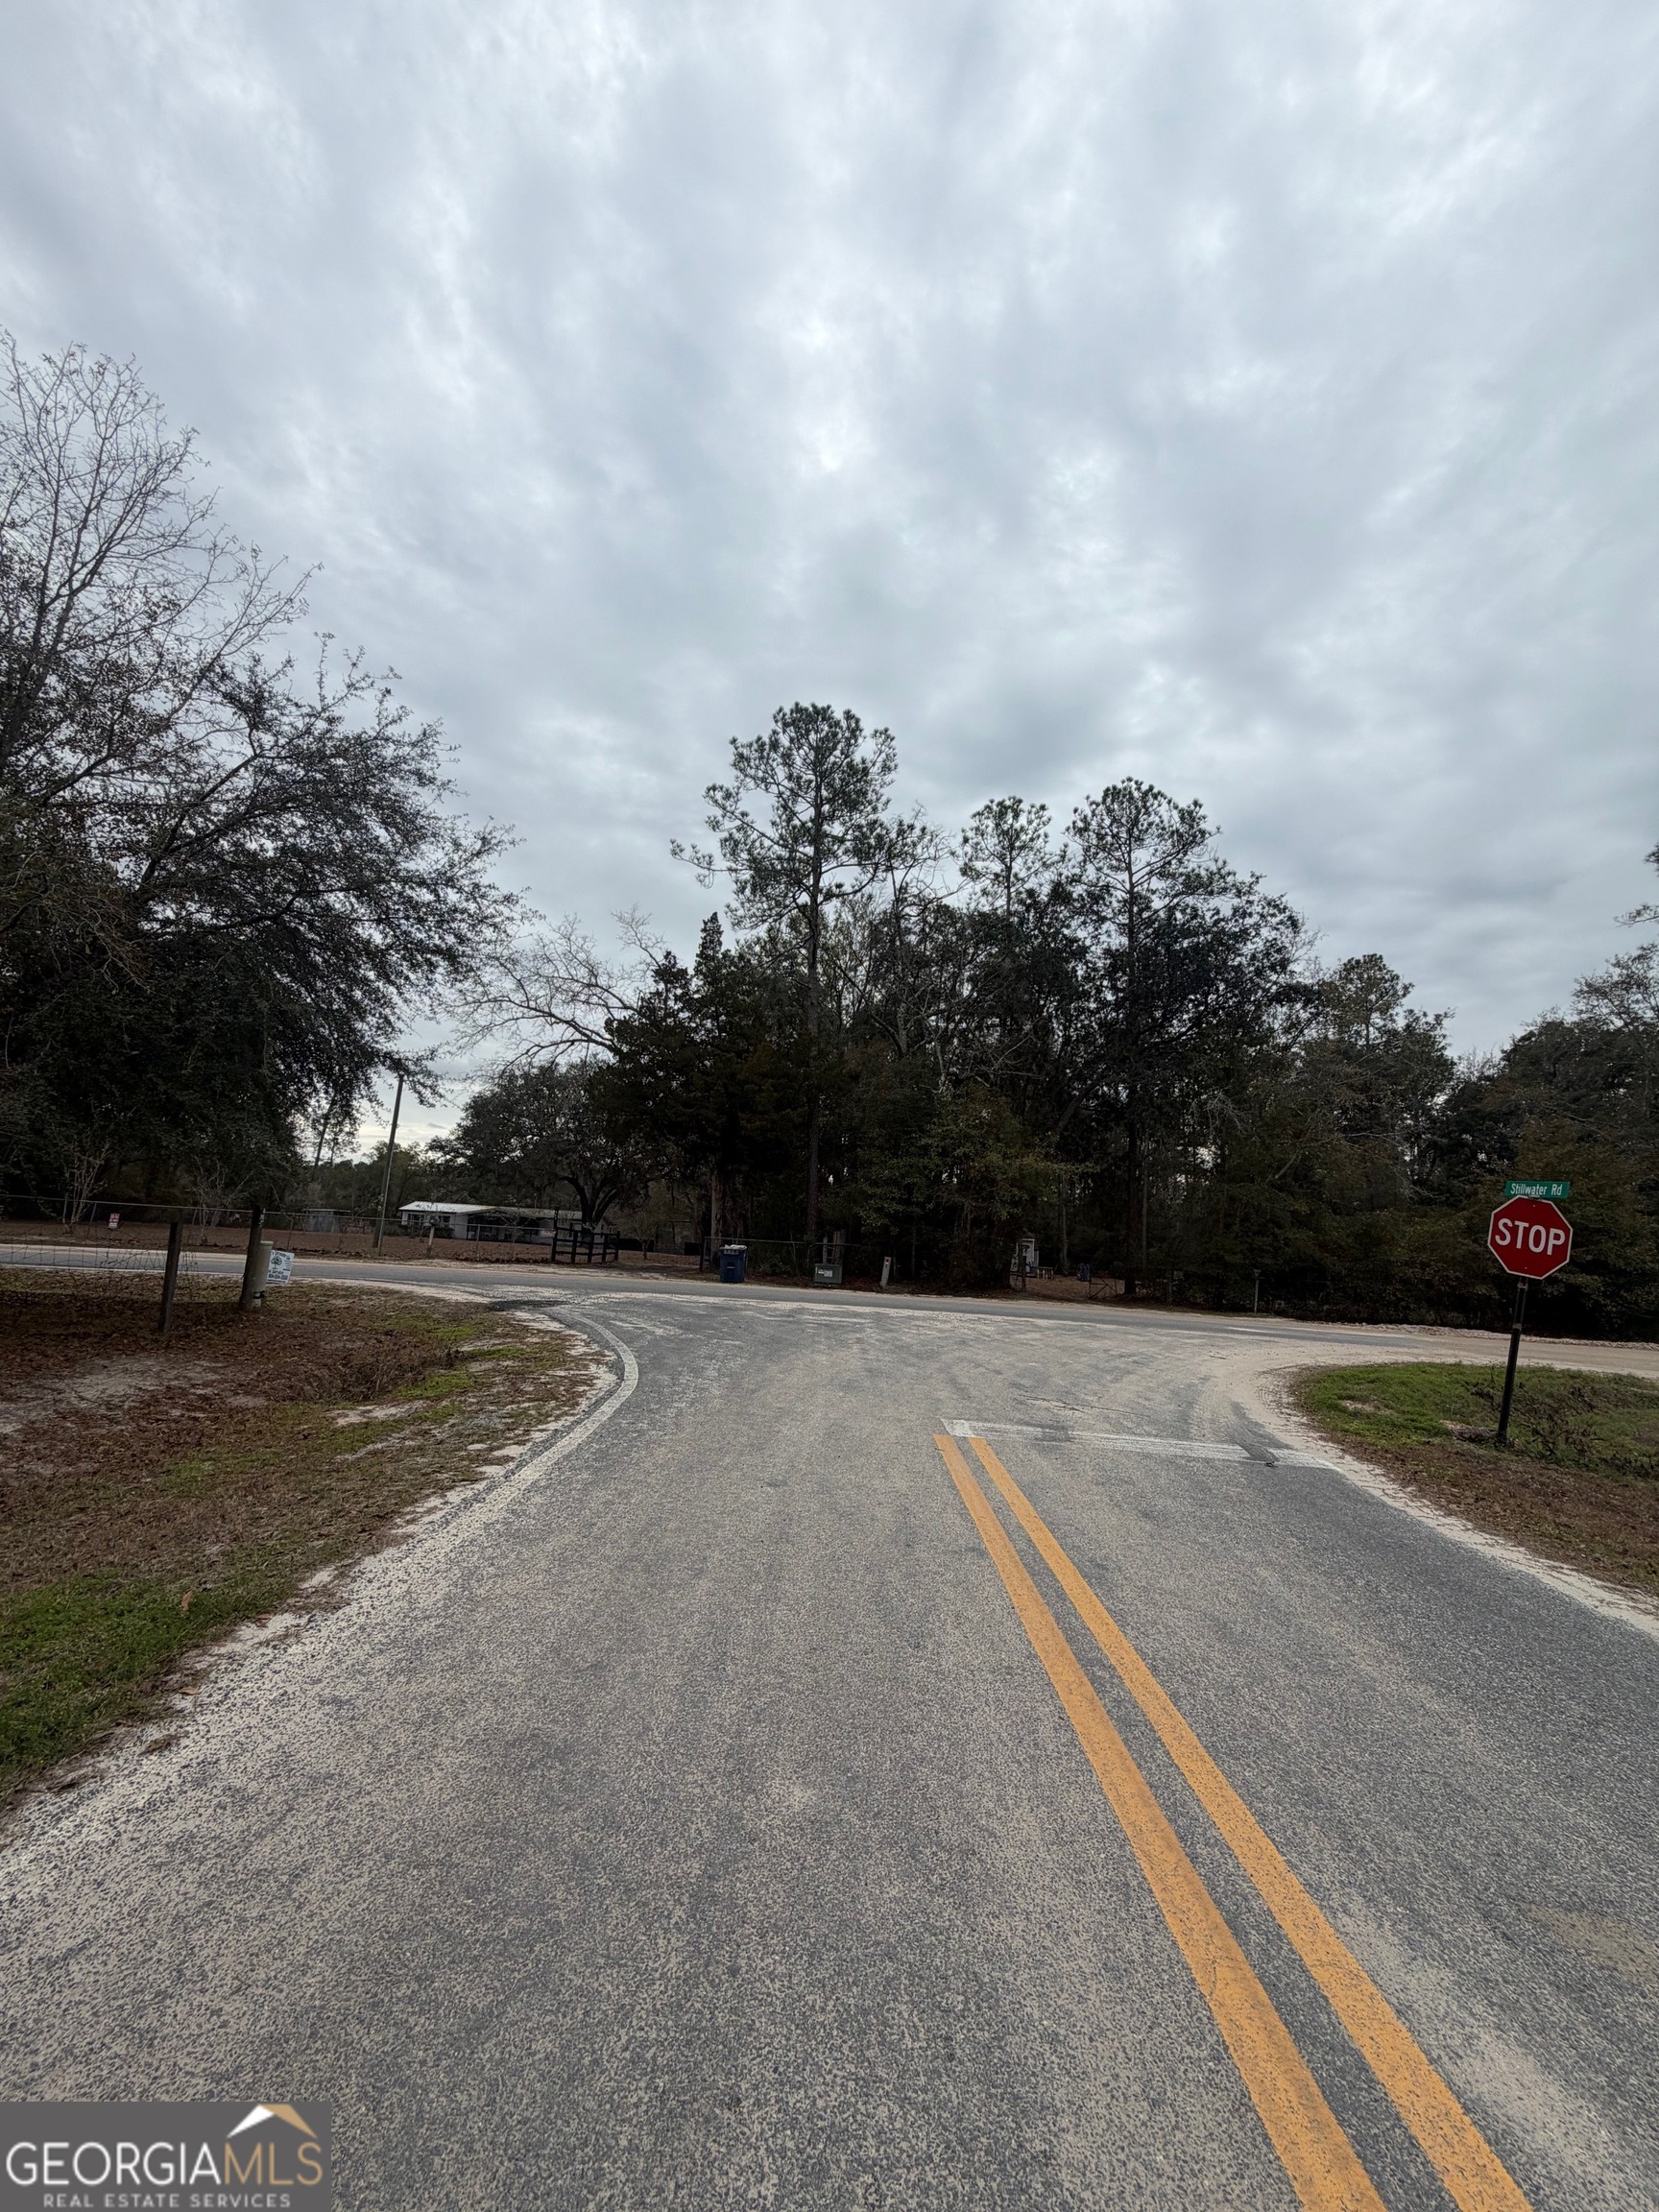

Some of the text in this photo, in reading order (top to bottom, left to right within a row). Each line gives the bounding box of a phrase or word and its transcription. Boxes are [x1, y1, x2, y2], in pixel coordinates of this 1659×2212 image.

[1510, 1183, 1563, 1196] Stillwater Rd
[1495, 1217, 1566, 1256] STOP
